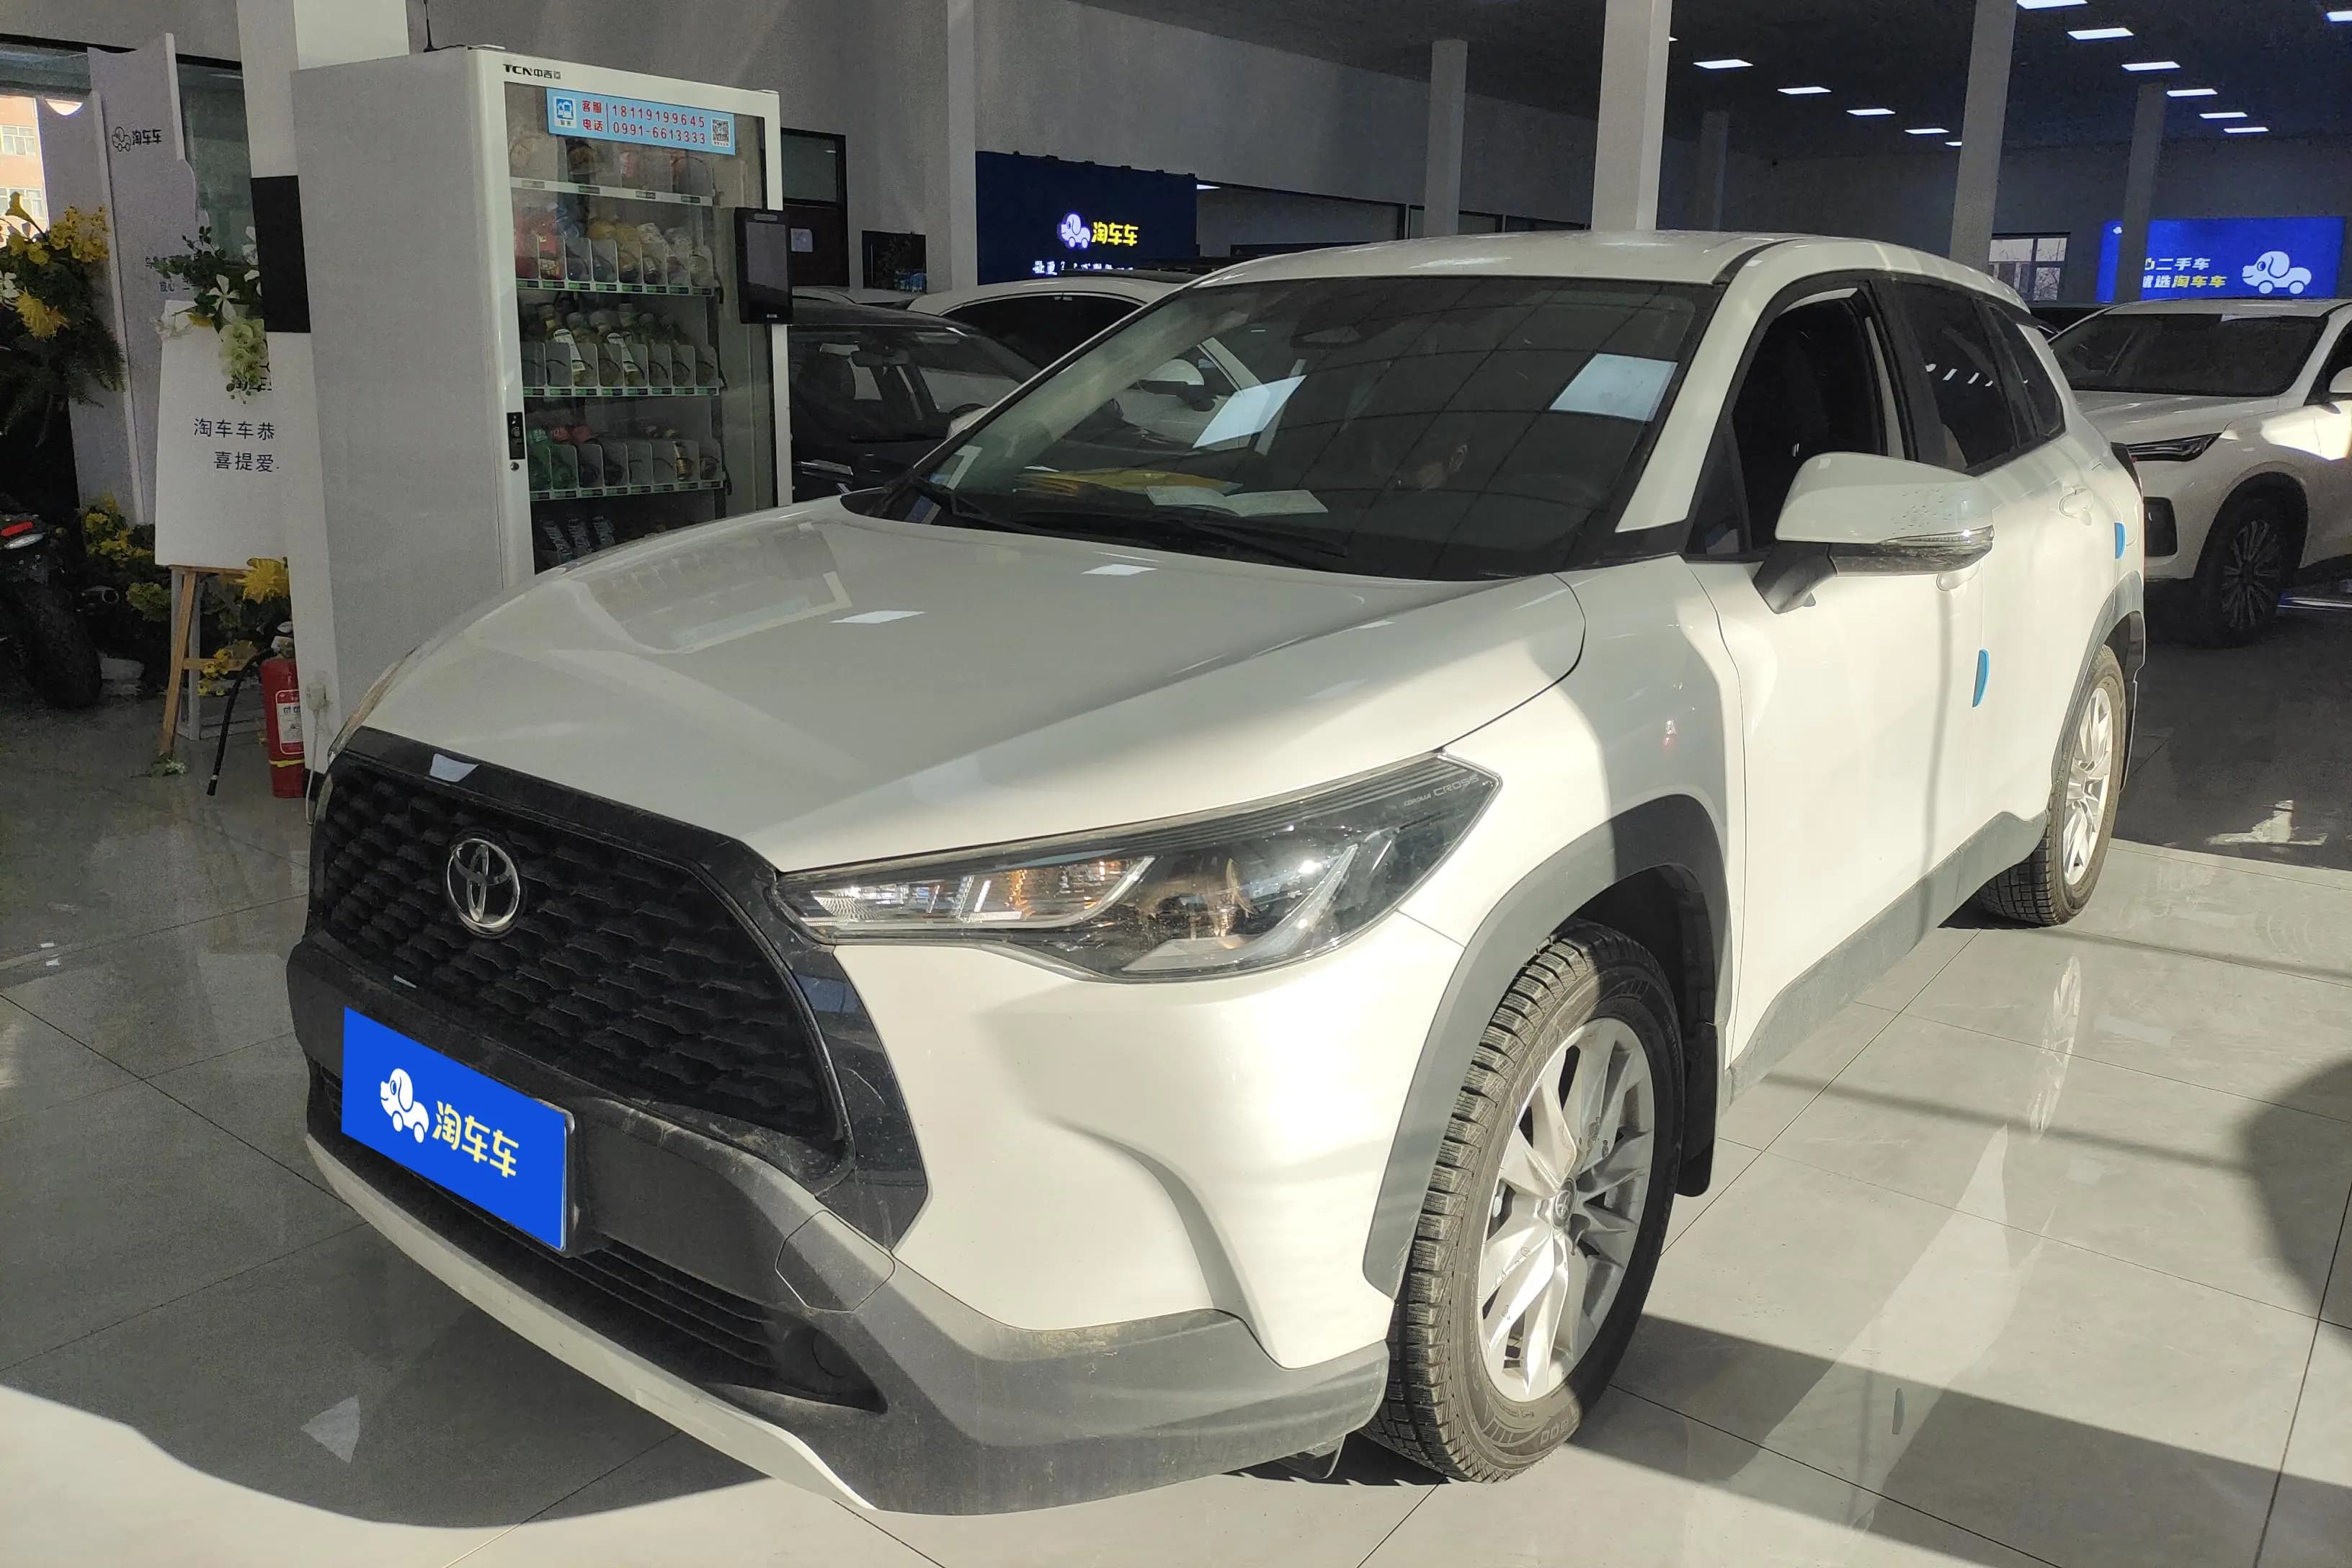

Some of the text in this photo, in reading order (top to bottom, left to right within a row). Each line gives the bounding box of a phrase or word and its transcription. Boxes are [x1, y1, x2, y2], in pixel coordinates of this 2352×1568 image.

[582, 100, 705, 128] 客服 18119199645
[132, 128, 162, 146] 淘车车
[582, 118, 705, 144] 电话 0991-6613333
[1091, 221, 1139, 246] 淘车车
[194, 418, 275, 441] 淘车车恭
[213, 450, 279, 473] 喜提爱
[1433, 774, 1479, 796] CROSS
